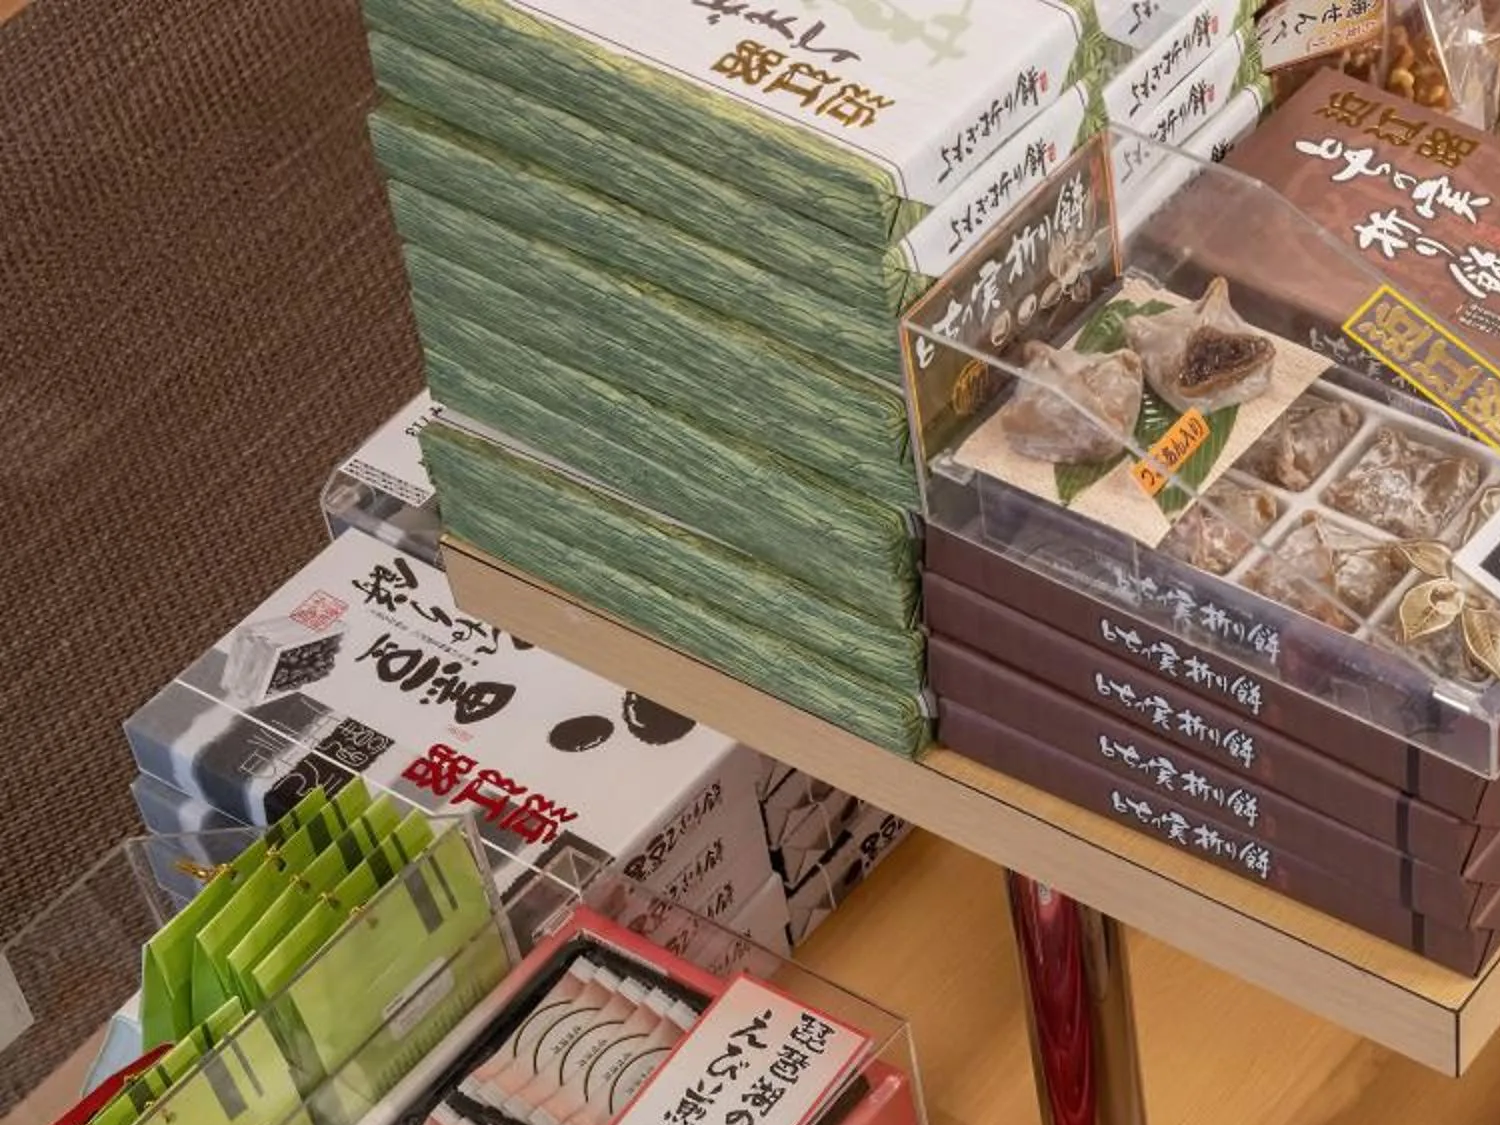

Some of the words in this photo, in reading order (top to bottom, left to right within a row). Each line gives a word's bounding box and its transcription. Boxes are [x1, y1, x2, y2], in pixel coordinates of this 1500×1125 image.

[710, 40, 895, 128] 近江路
[1315, 91, 1481, 168] 近江路
[402, 743, 579, 844] 近江路
